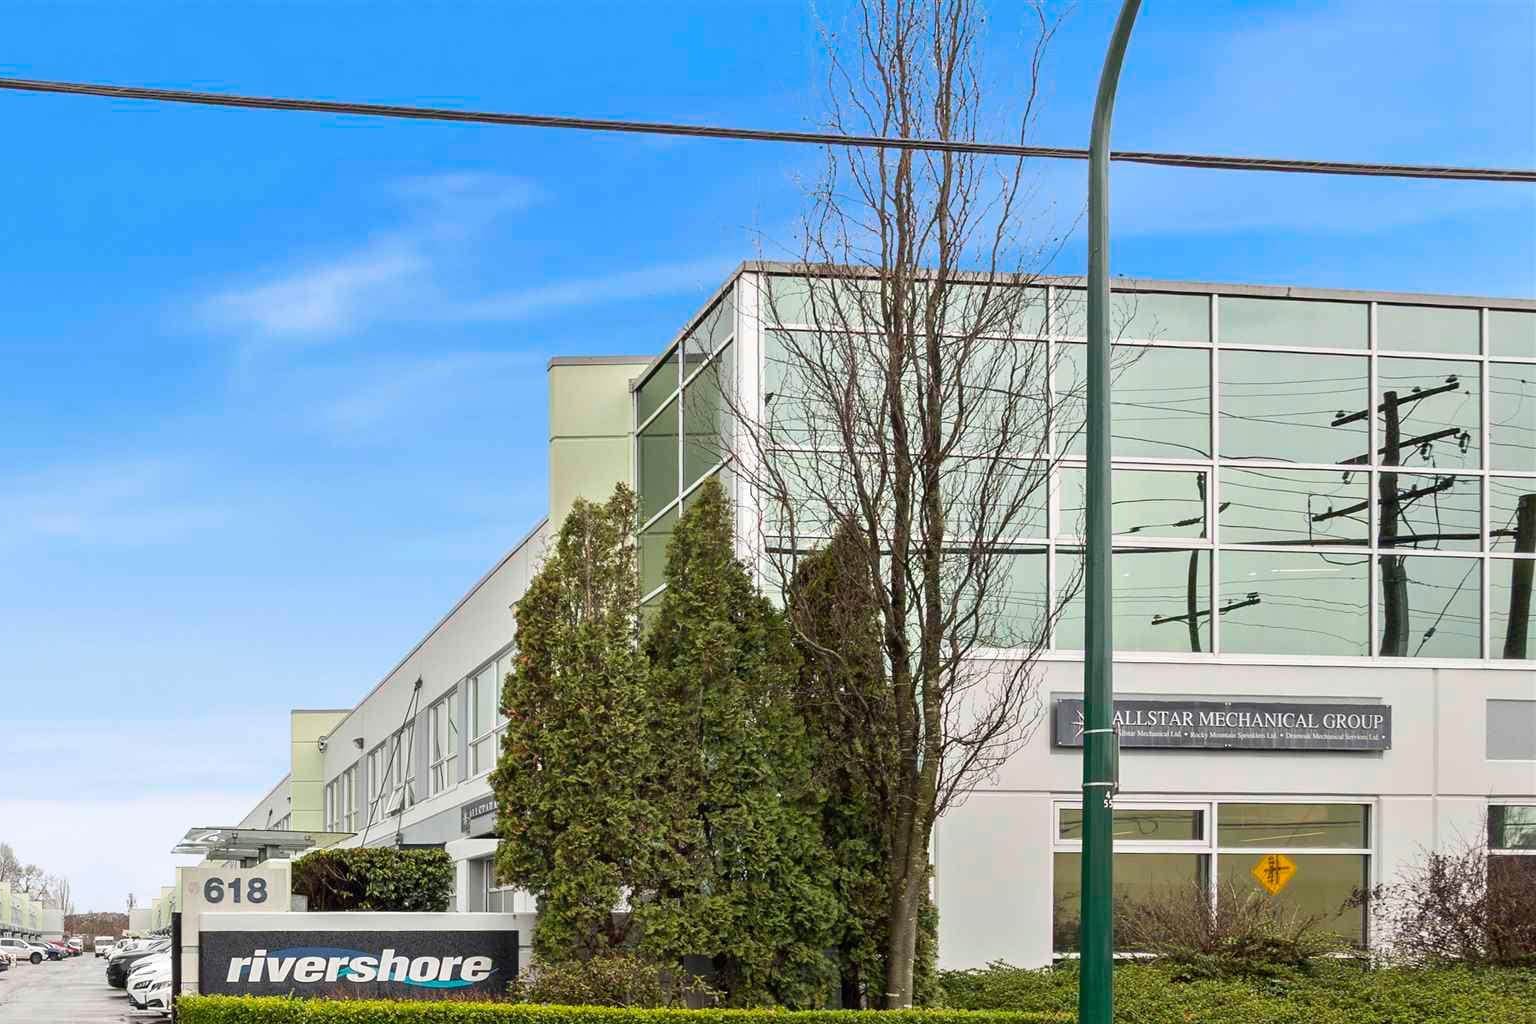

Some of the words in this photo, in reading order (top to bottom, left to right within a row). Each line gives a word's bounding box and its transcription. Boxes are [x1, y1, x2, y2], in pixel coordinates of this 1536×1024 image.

[1112, 710, 1194, 727] ALLSTAR
[1199, 711, 1320, 729] MECHANICAL
[1323, 713, 1384, 730] GROUP
[1105, 791, 1112, 799] 4
[203, 877, 268, 904] 618
[226, 949, 494, 983] rivershore
